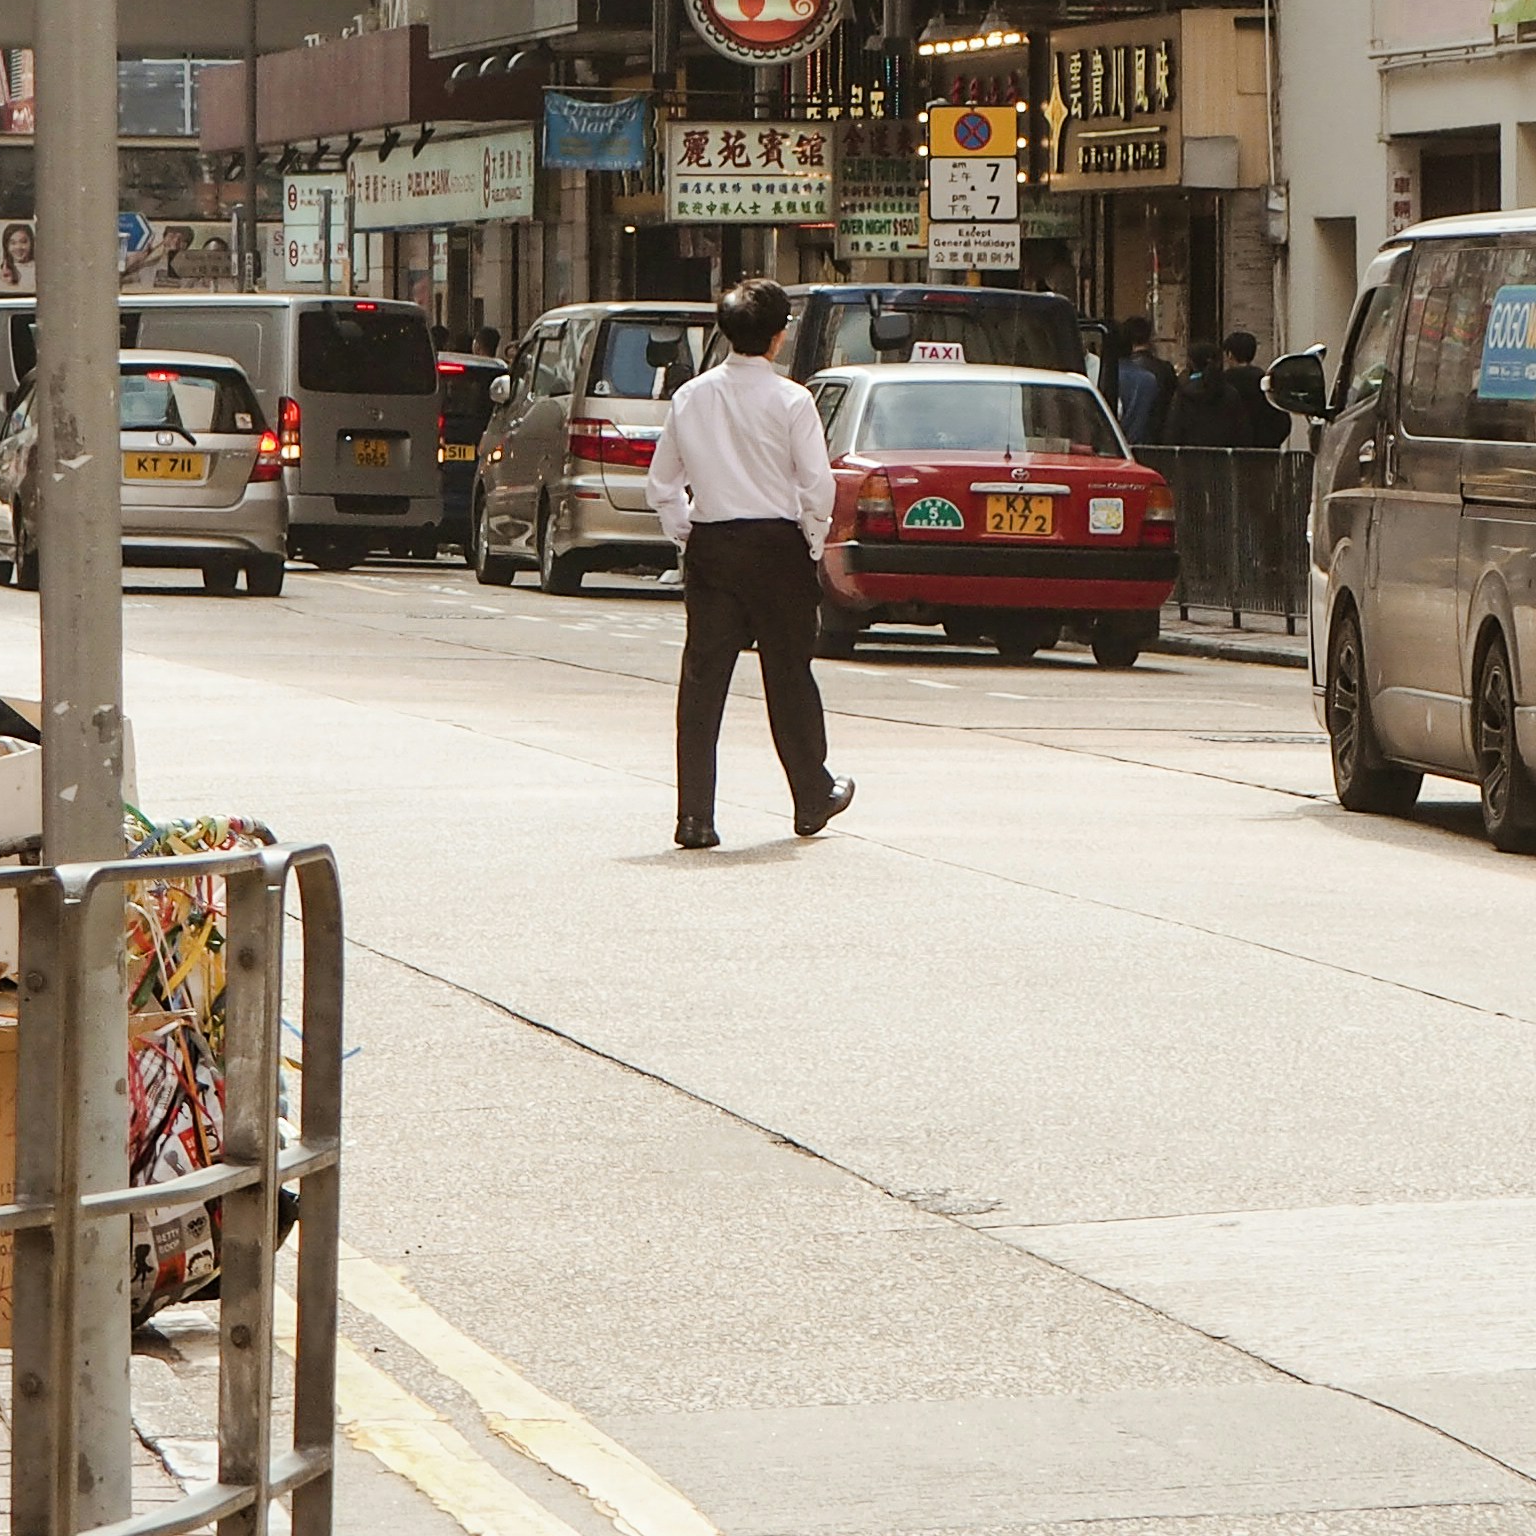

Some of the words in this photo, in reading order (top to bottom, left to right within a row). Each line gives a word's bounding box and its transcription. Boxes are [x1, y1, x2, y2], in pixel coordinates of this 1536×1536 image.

[948, 171, 971, 182] 上午
[951, 161, 968, 169] am
[986, 162, 1000, 183] 7
[948, 204, 972, 215] 下午
[951, 193, 968, 203] pm
[986, 195, 1000, 215] 7
[839, 217, 864, 236] OVER
[864, 217, 892, 236] NIGHT
[958, 227, 992, 238] Except
[933, 238, 972, 247] General
[974, 238, 1016, 249] Holidays
[918, 344, 964, 361] TAXI
[136, 457, 162, 477] KT
[167, 457, 193, 476] 711
[928, 506, 940, 520] 5
[1005, 495, 1034, 515] KX
[991, 512, 1047, 533] 2172
[156, 1229, 181, 1244] BETTY
